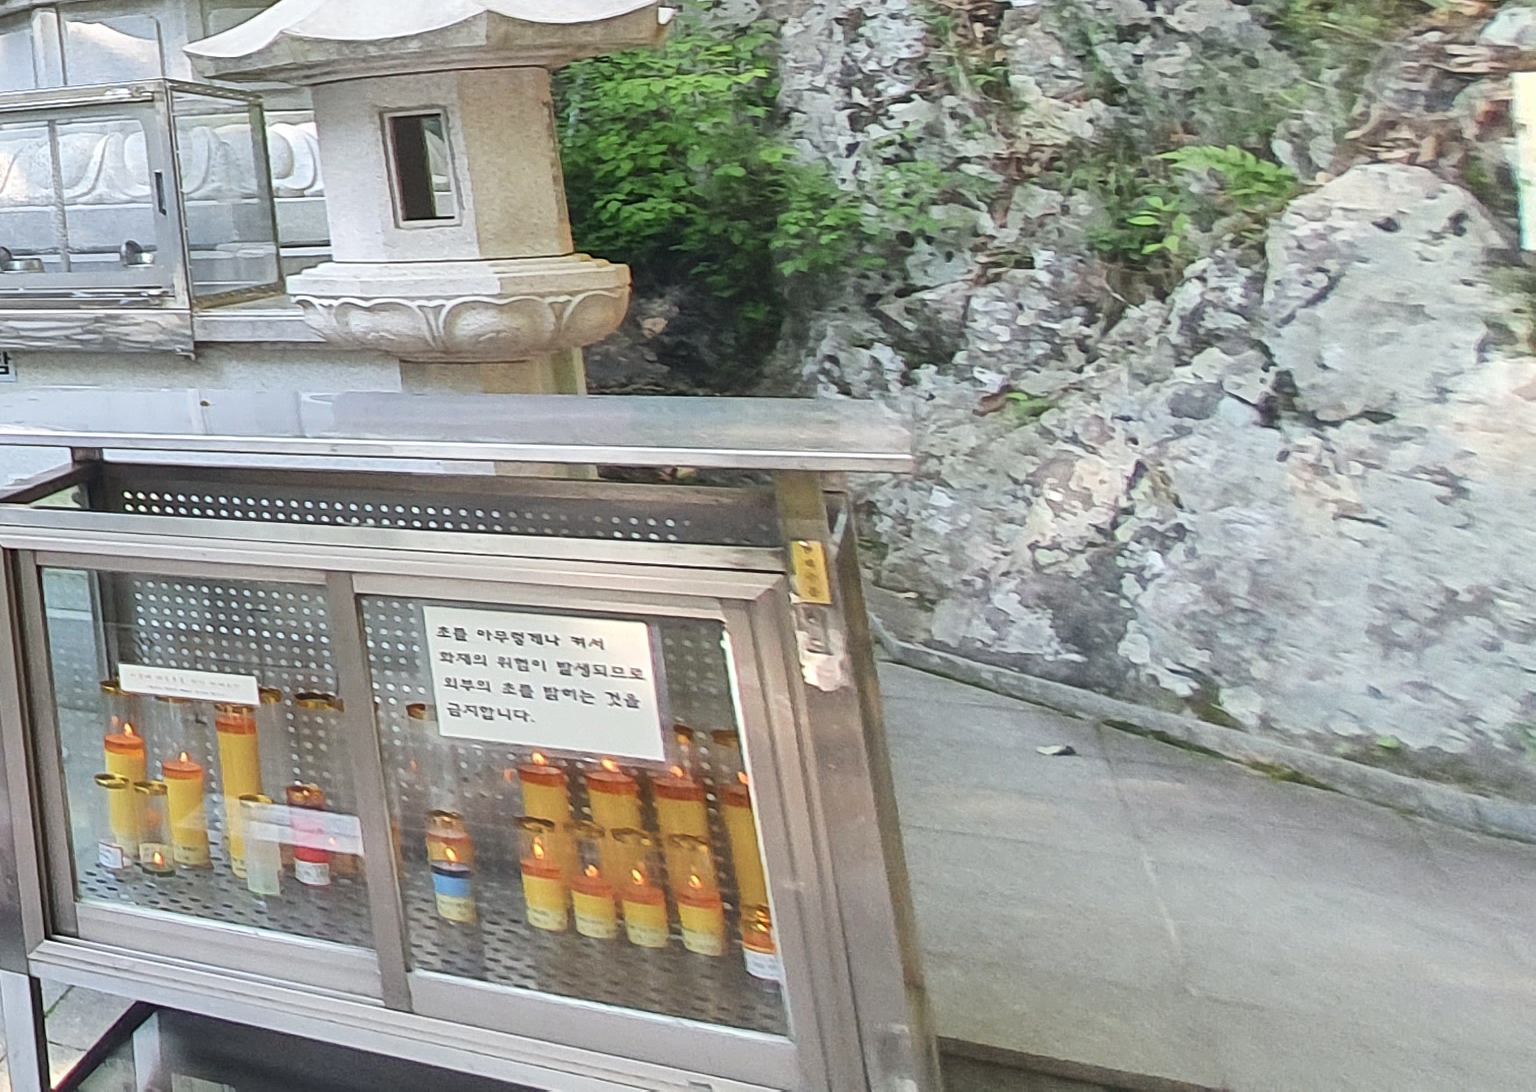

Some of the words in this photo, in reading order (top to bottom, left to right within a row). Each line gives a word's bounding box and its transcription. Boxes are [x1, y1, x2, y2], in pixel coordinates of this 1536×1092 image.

[436, 625, 468, 642] 초를
[476, 629, 561, 647] 아무렇게나
[570, 635, 605, 651] 켜서
[439, 651, 488, 667] 화재의
[496, 656, 547, 673] 위험이
[556, 661, 646, 680] 발생되므로
[443, 676, 492, 693] 외부의
[502, 681, 535, 699] 초를
[604, 691, 641, 709] 것을
[446, 702, 536, 723] 금지합니다.
